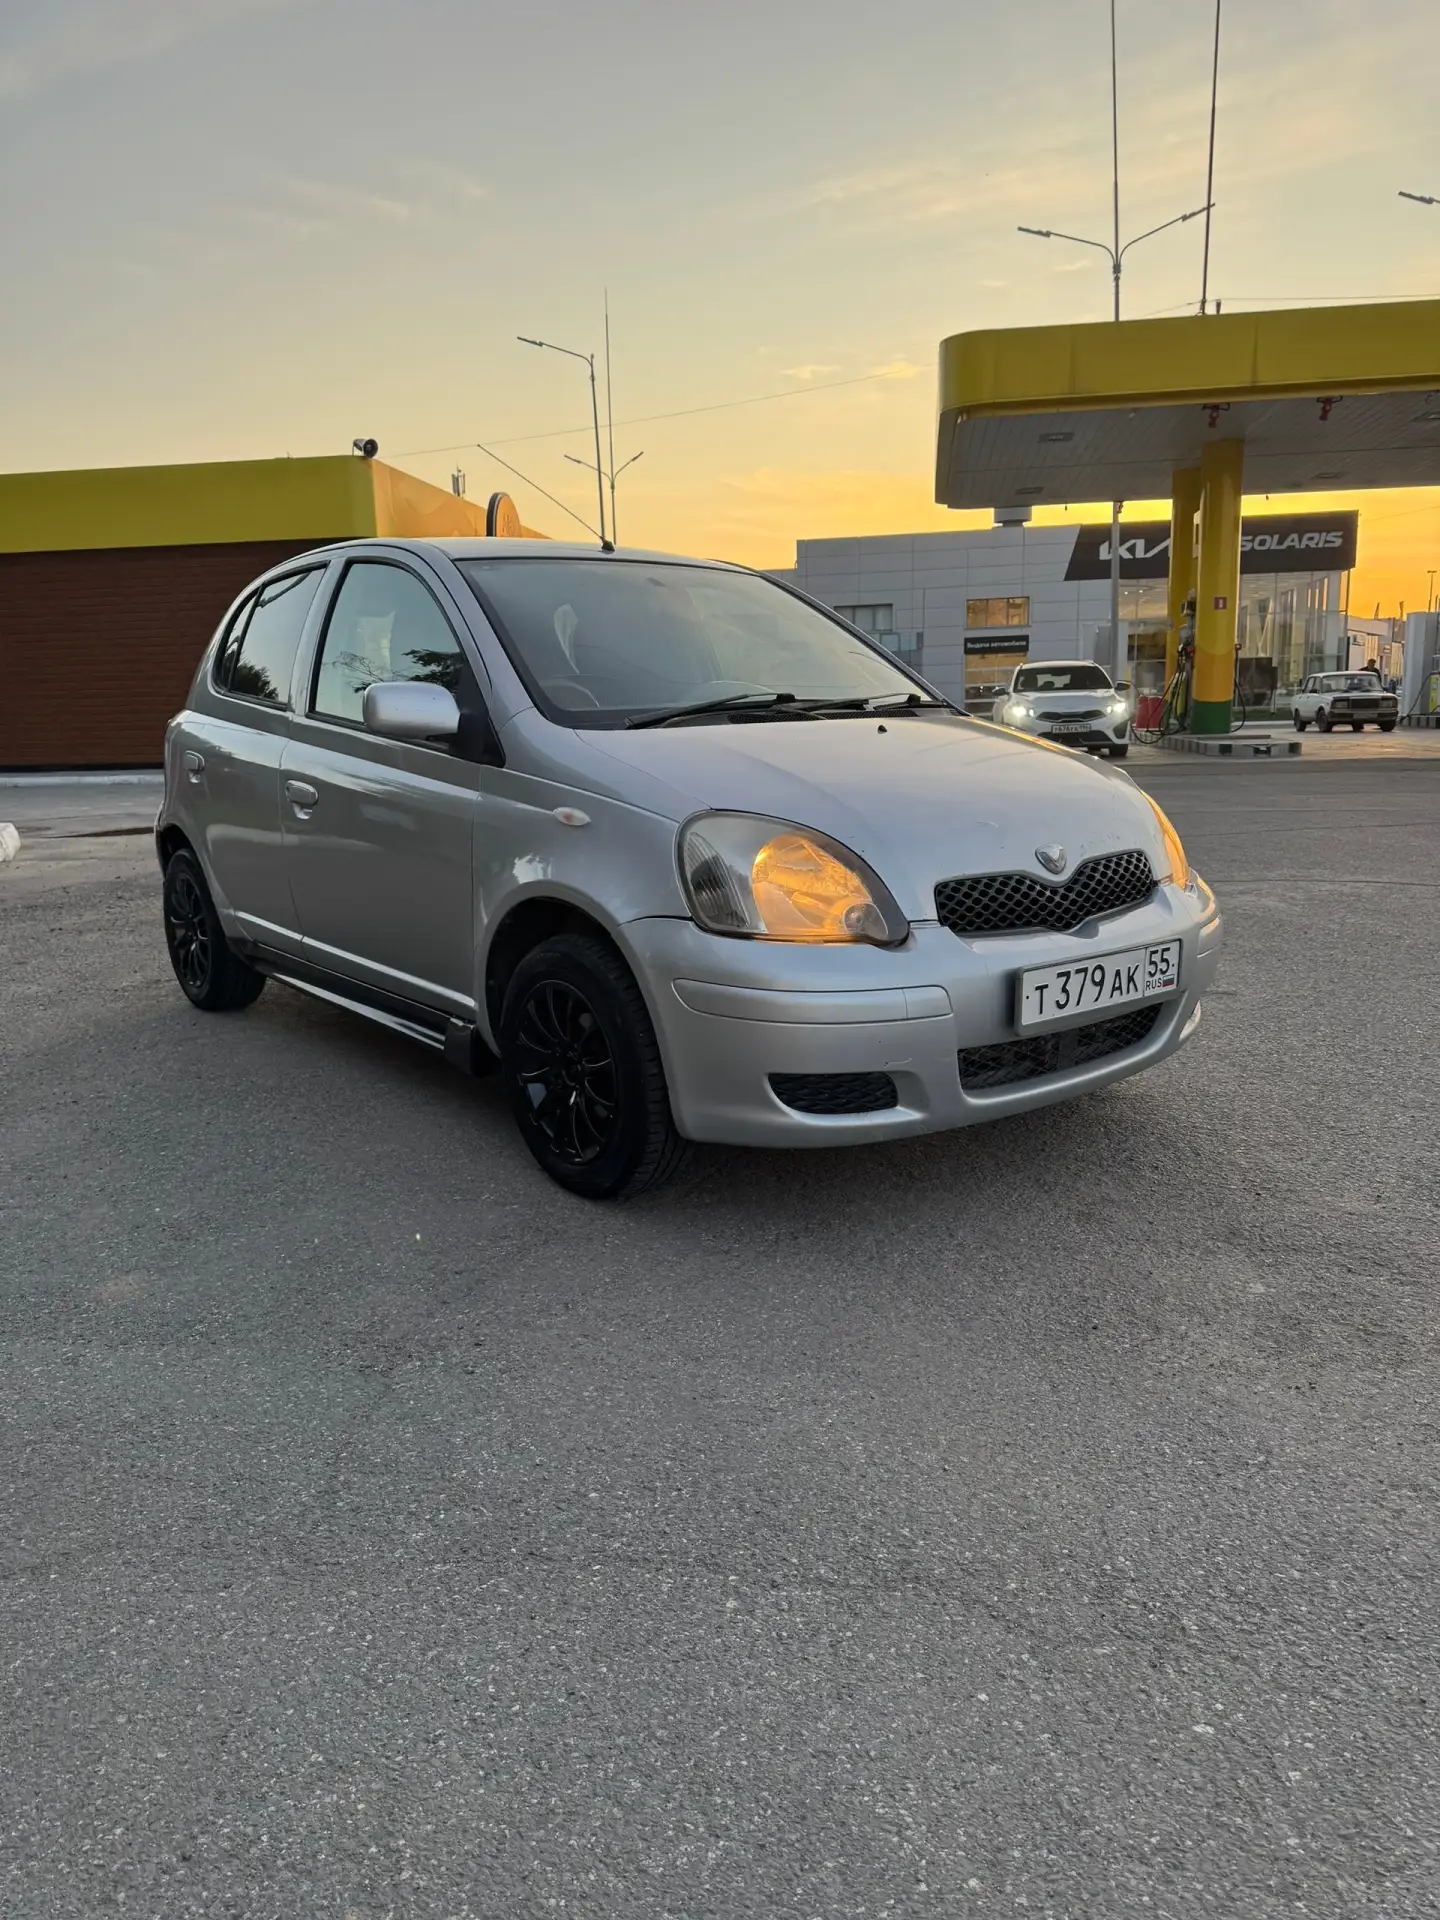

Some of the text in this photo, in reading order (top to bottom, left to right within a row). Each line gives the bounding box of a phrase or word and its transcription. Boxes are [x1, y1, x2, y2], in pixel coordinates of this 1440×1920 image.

[1240, 531, 1344, 552] SOLARIS
[1147, 947, 1171, 978] 55
[1145, 977, 1162, 991] RUS
